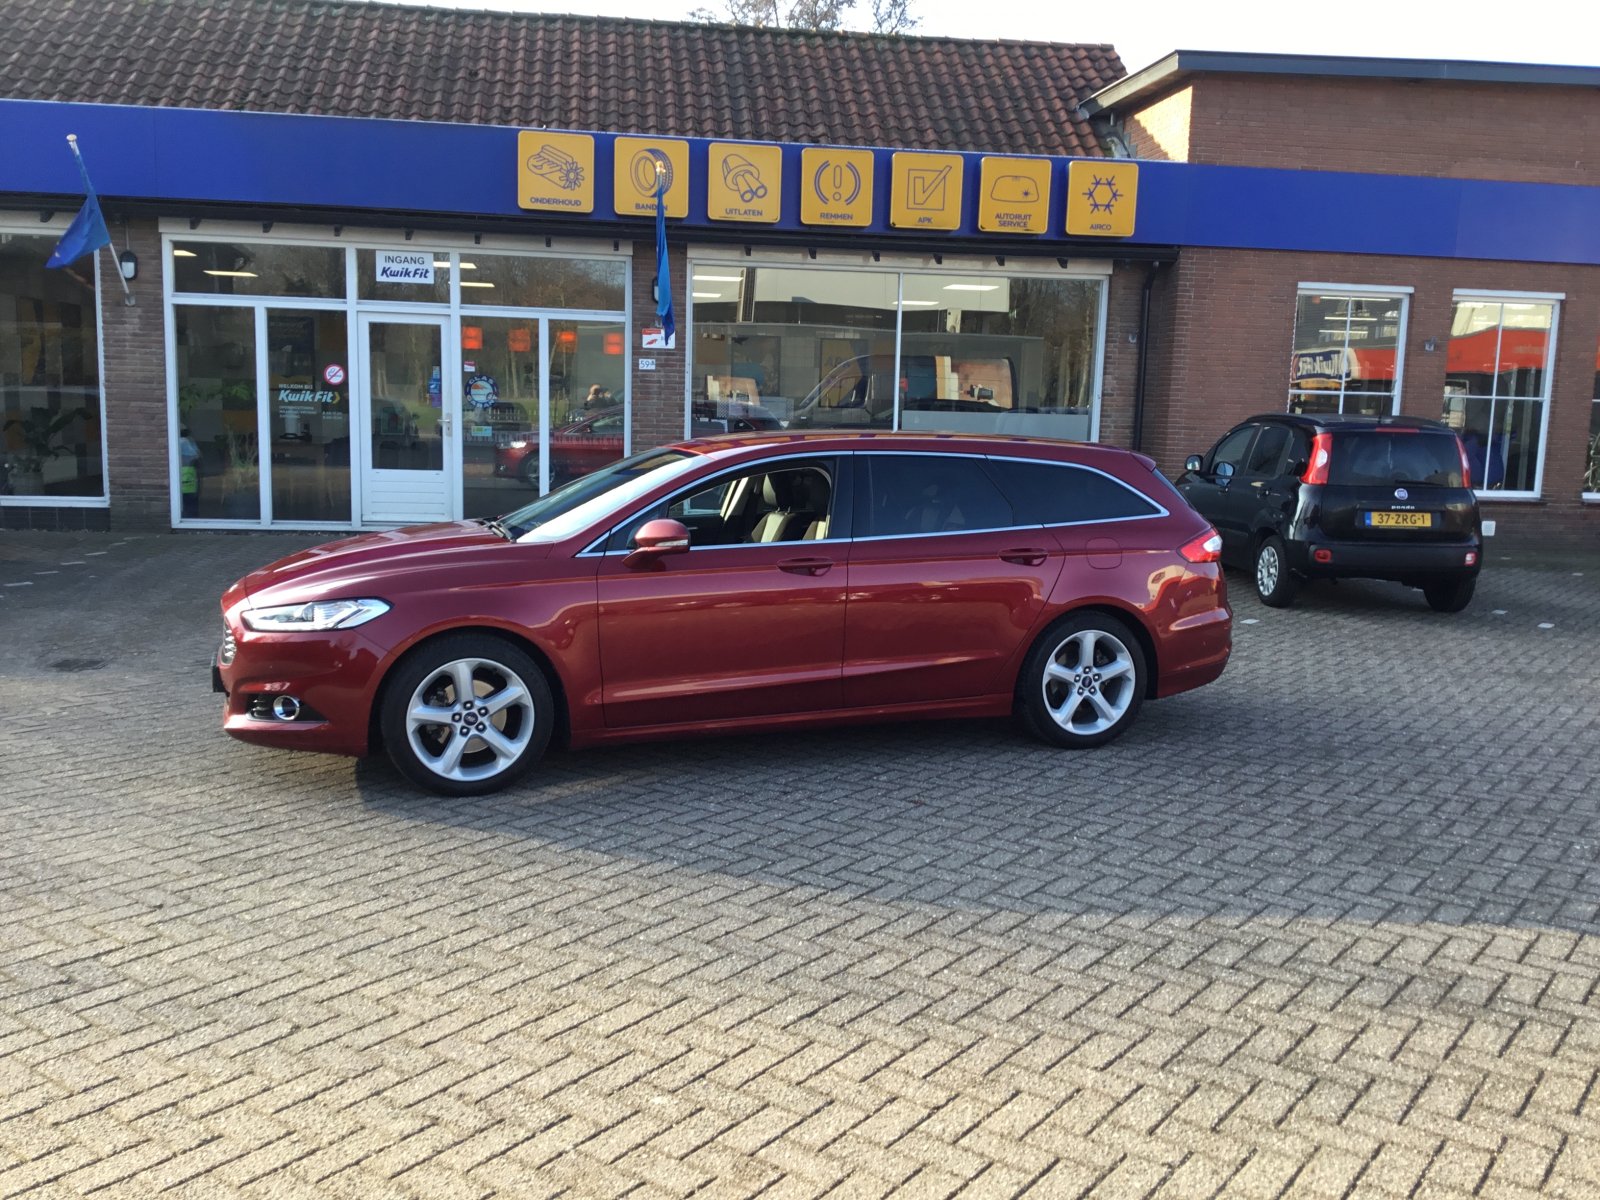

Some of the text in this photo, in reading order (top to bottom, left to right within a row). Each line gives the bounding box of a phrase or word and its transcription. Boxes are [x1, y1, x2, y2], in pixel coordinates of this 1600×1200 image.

[530, 196, 582, 207] ONDERHOUD
[635, 203, 668, 212] BANDN
[725, 208, 763, 217] UITLATEN
[820, 212, 853, 221] REMMEN
[995, 213, 1032, 221] AUTORUIT
[917, 216, 933, 224] APK
[998, 220, 1028, 228] SERVICE
[1089, 223, 1112, 231] AIRCO
[384, 255, 425, 265] INGANG
[1377, 513, 1426, 525] 37-ZRG-1
